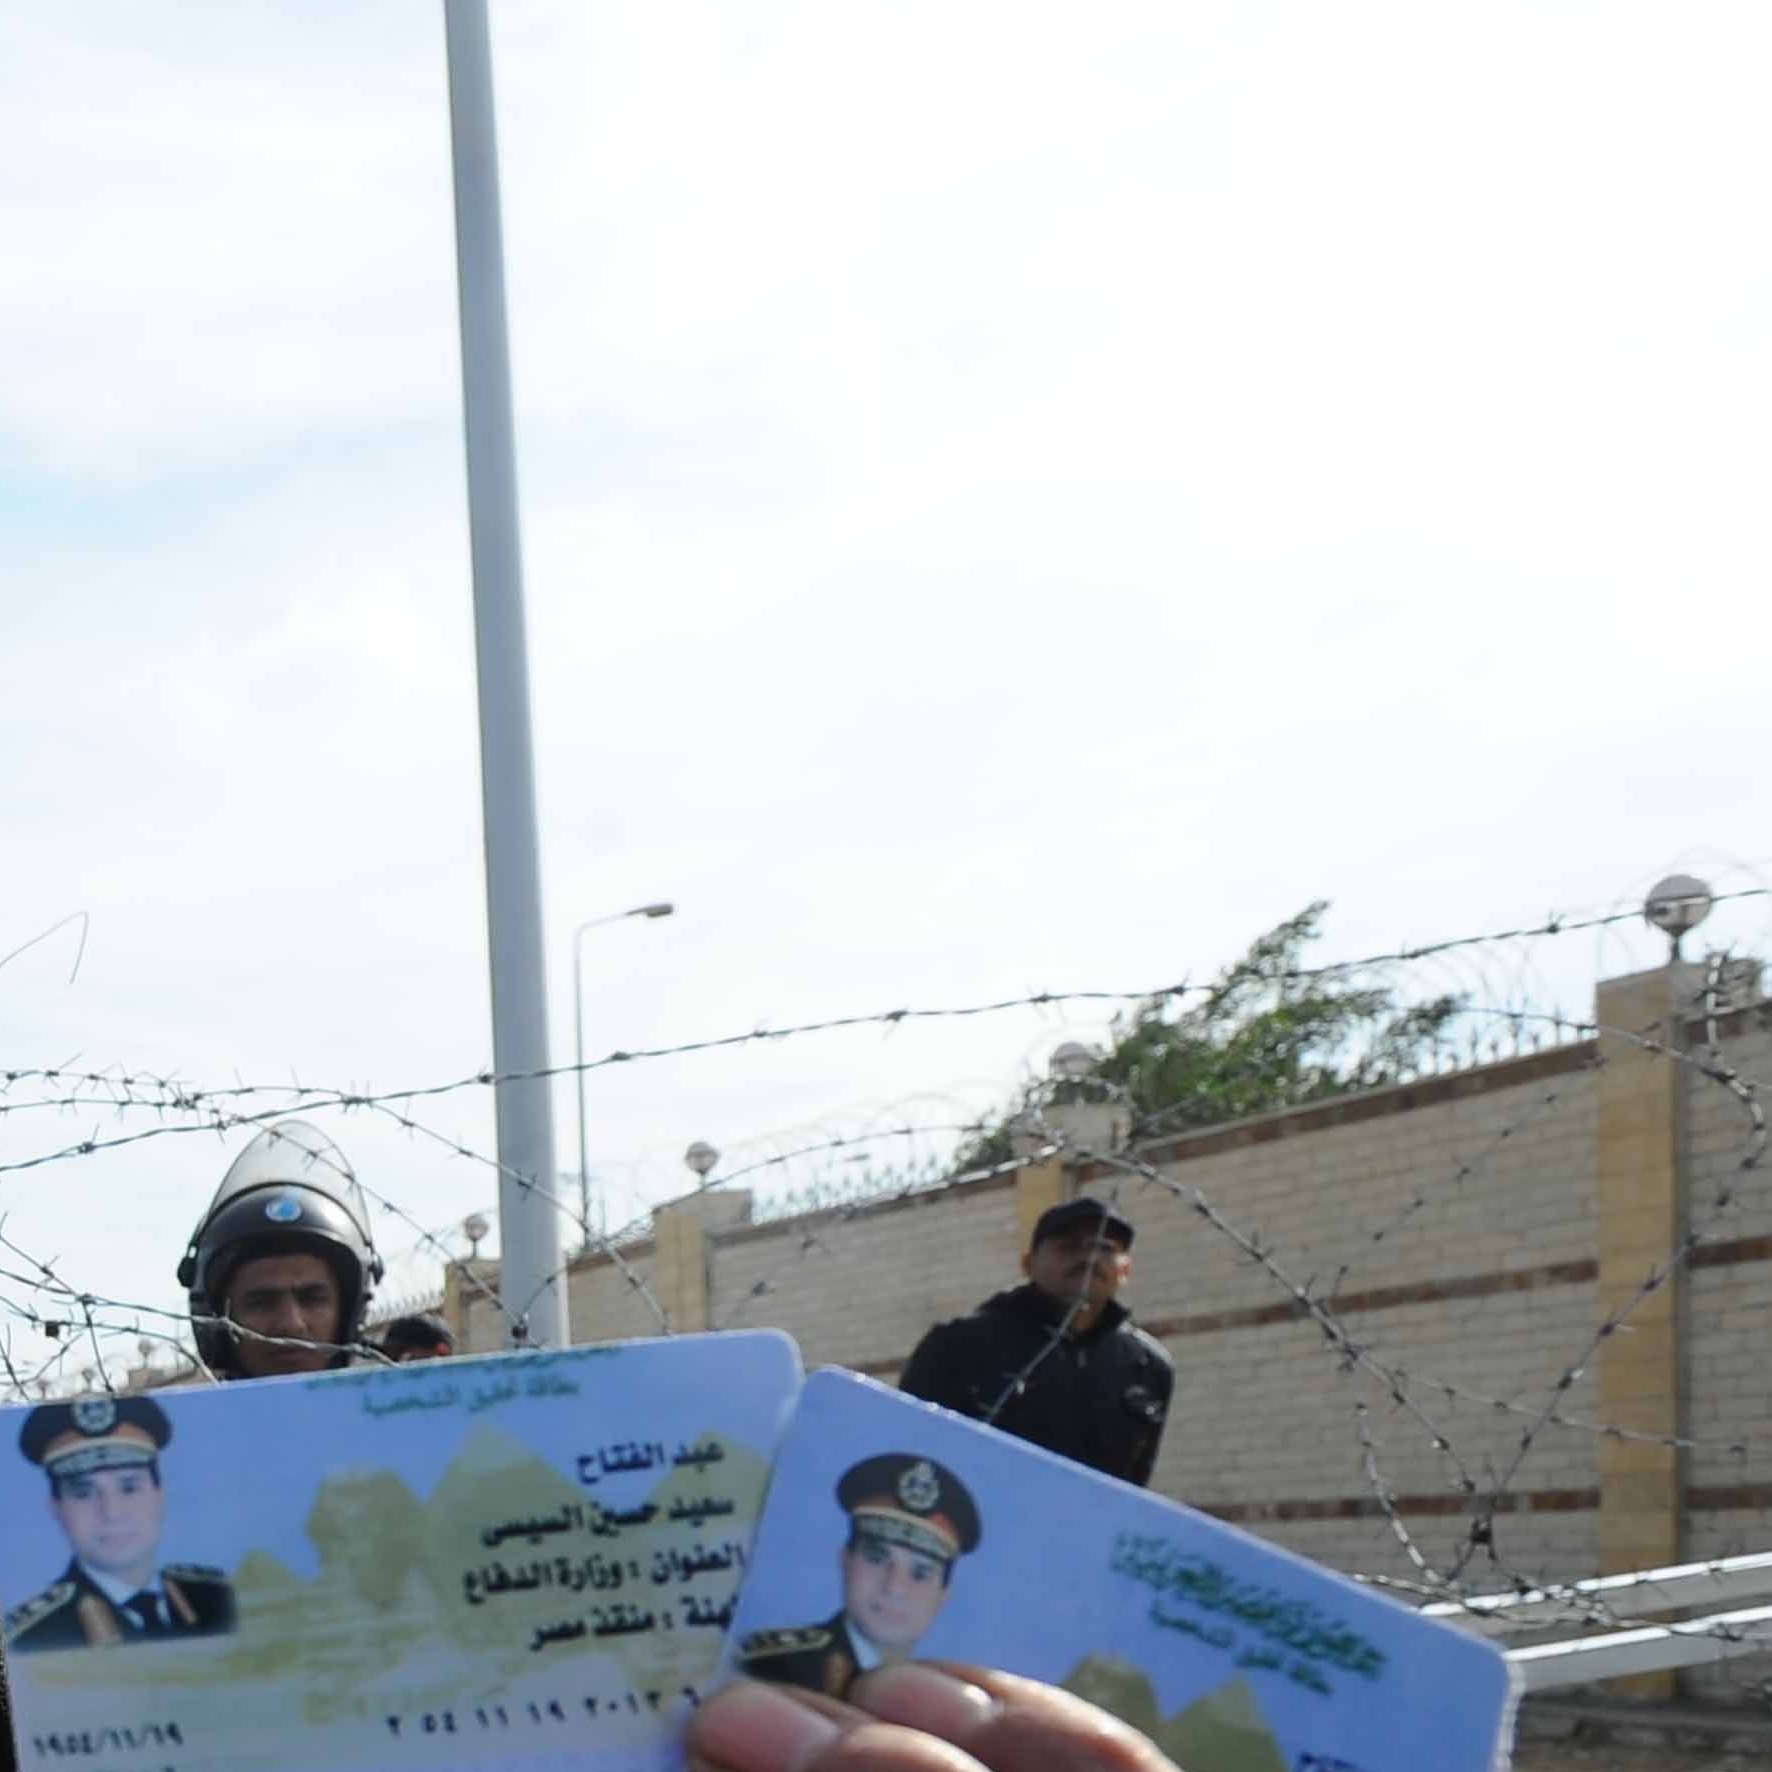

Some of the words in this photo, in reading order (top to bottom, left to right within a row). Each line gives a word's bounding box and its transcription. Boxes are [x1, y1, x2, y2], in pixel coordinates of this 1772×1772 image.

[575, 1440, 666, 1486] الفتاح
[673, 1440, 725, 1473] عبد
[589, 1500, 660, 1538] حسين
[668, 1495, 735, 1527] سعيد
[555, 1554, 623, 1592] وزارة
[650, 1541, 746, 1584] العنوان
[462, 1562, 554, 1605] الدفاع
[529, 1619, 587, 1652] مصر
[592, 1602, 657, 1636] منقذ
